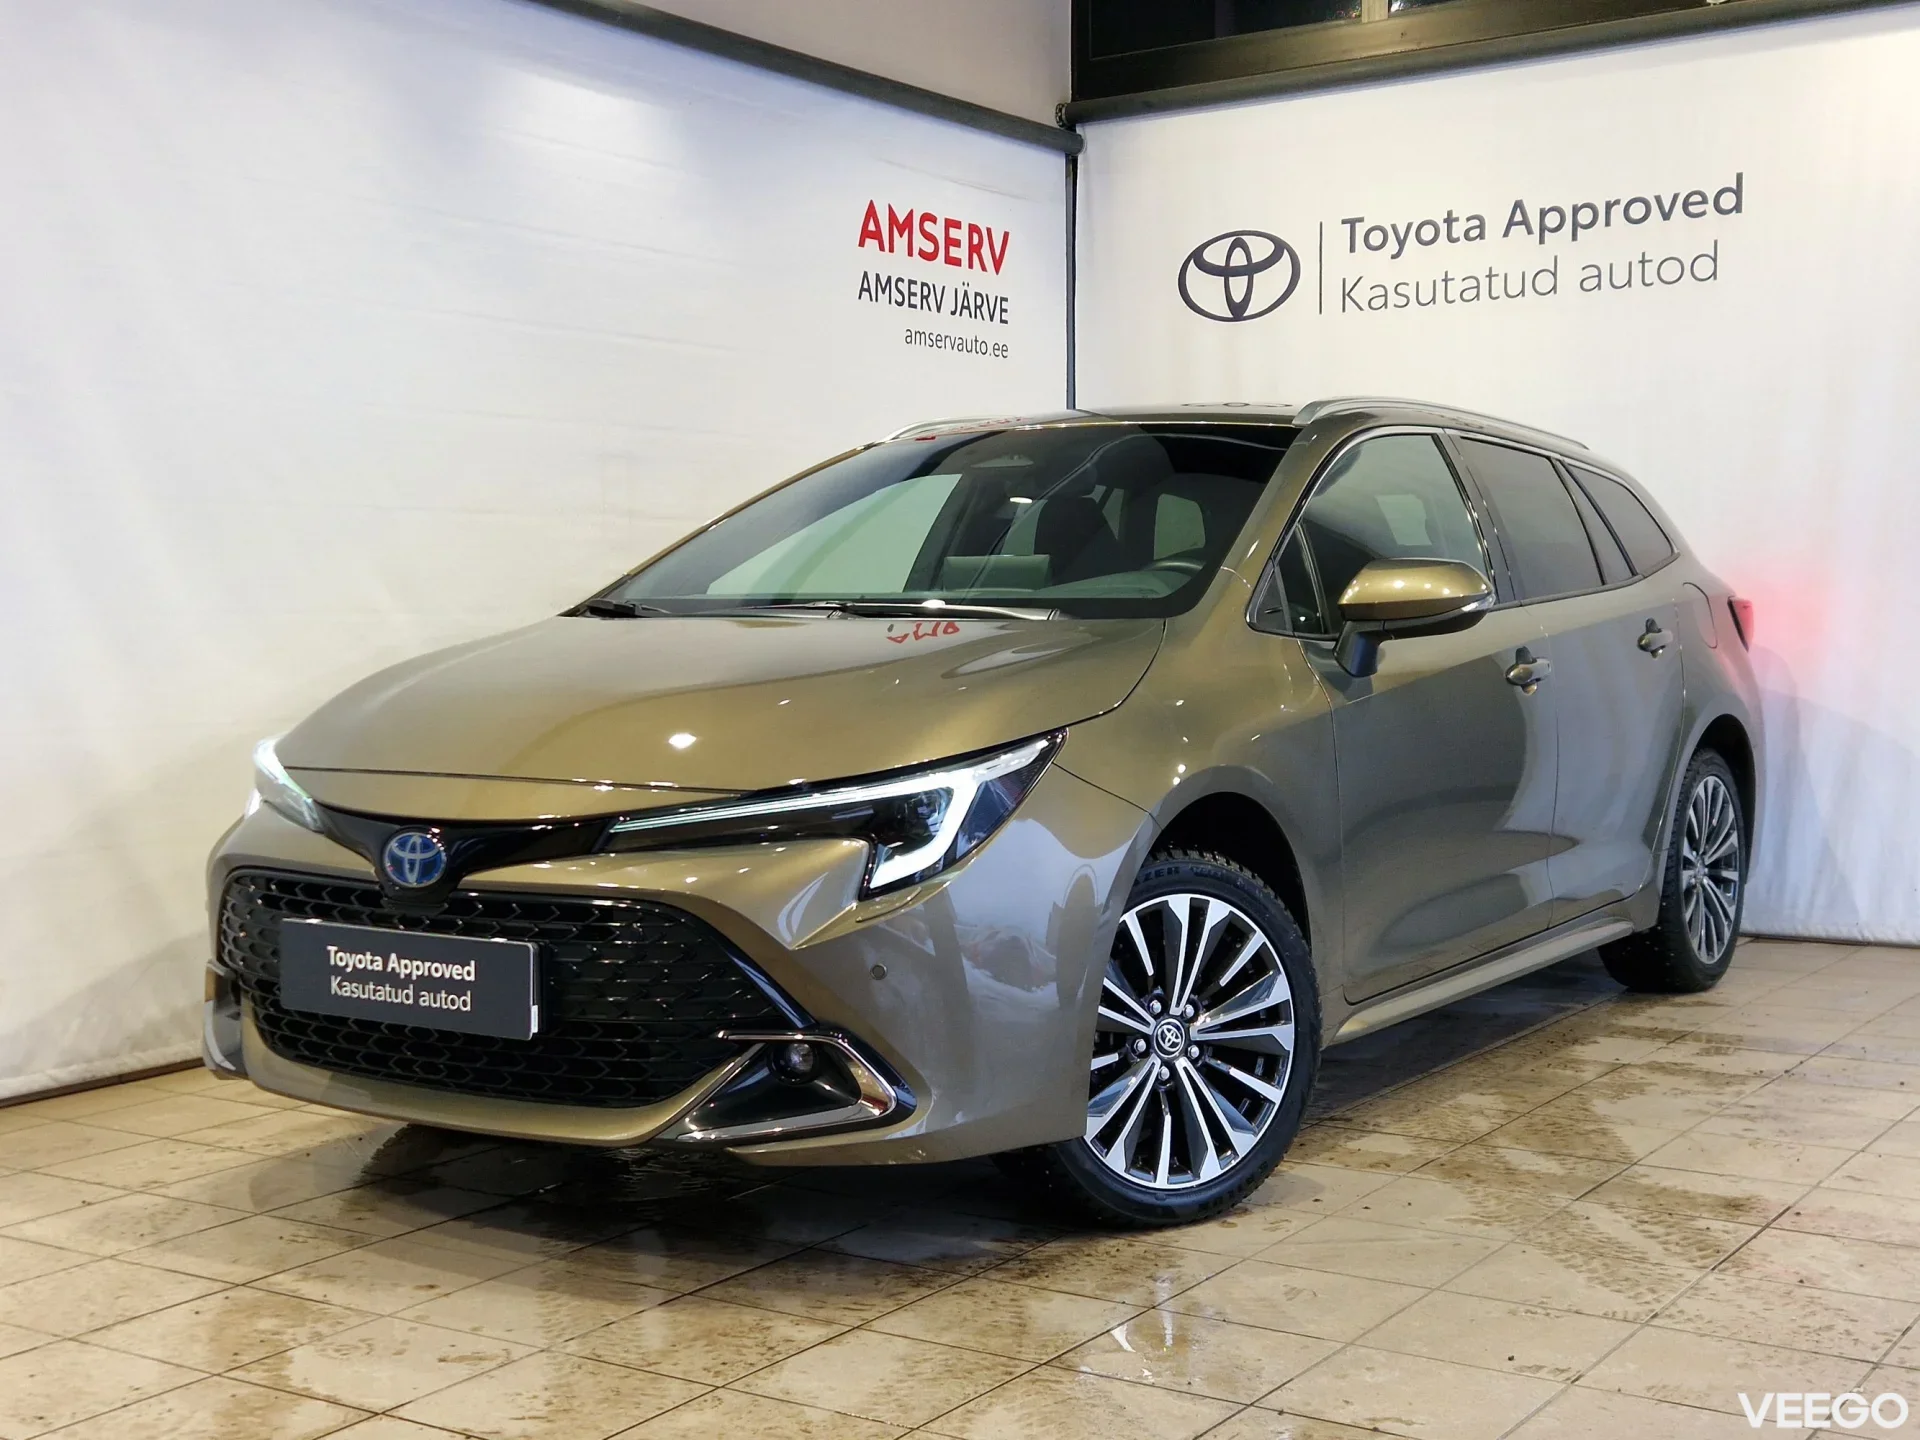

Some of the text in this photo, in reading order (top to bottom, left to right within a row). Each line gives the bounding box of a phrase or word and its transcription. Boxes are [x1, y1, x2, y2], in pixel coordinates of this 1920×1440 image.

[858, 199, 1010, 276] AMSERV
[1341, 172, 1743, 260] Toyota Approved
[858, 270, 1009, 325] AMSERV JÄRVE
[1341, 239, 1719, 313] Kasutatud autod
[905, 328, 1009, 359] amservauto.ee
[326, 945, 476, 982] Toyota Approved
[330, 975, 471, 1012] Kasutatud autod
